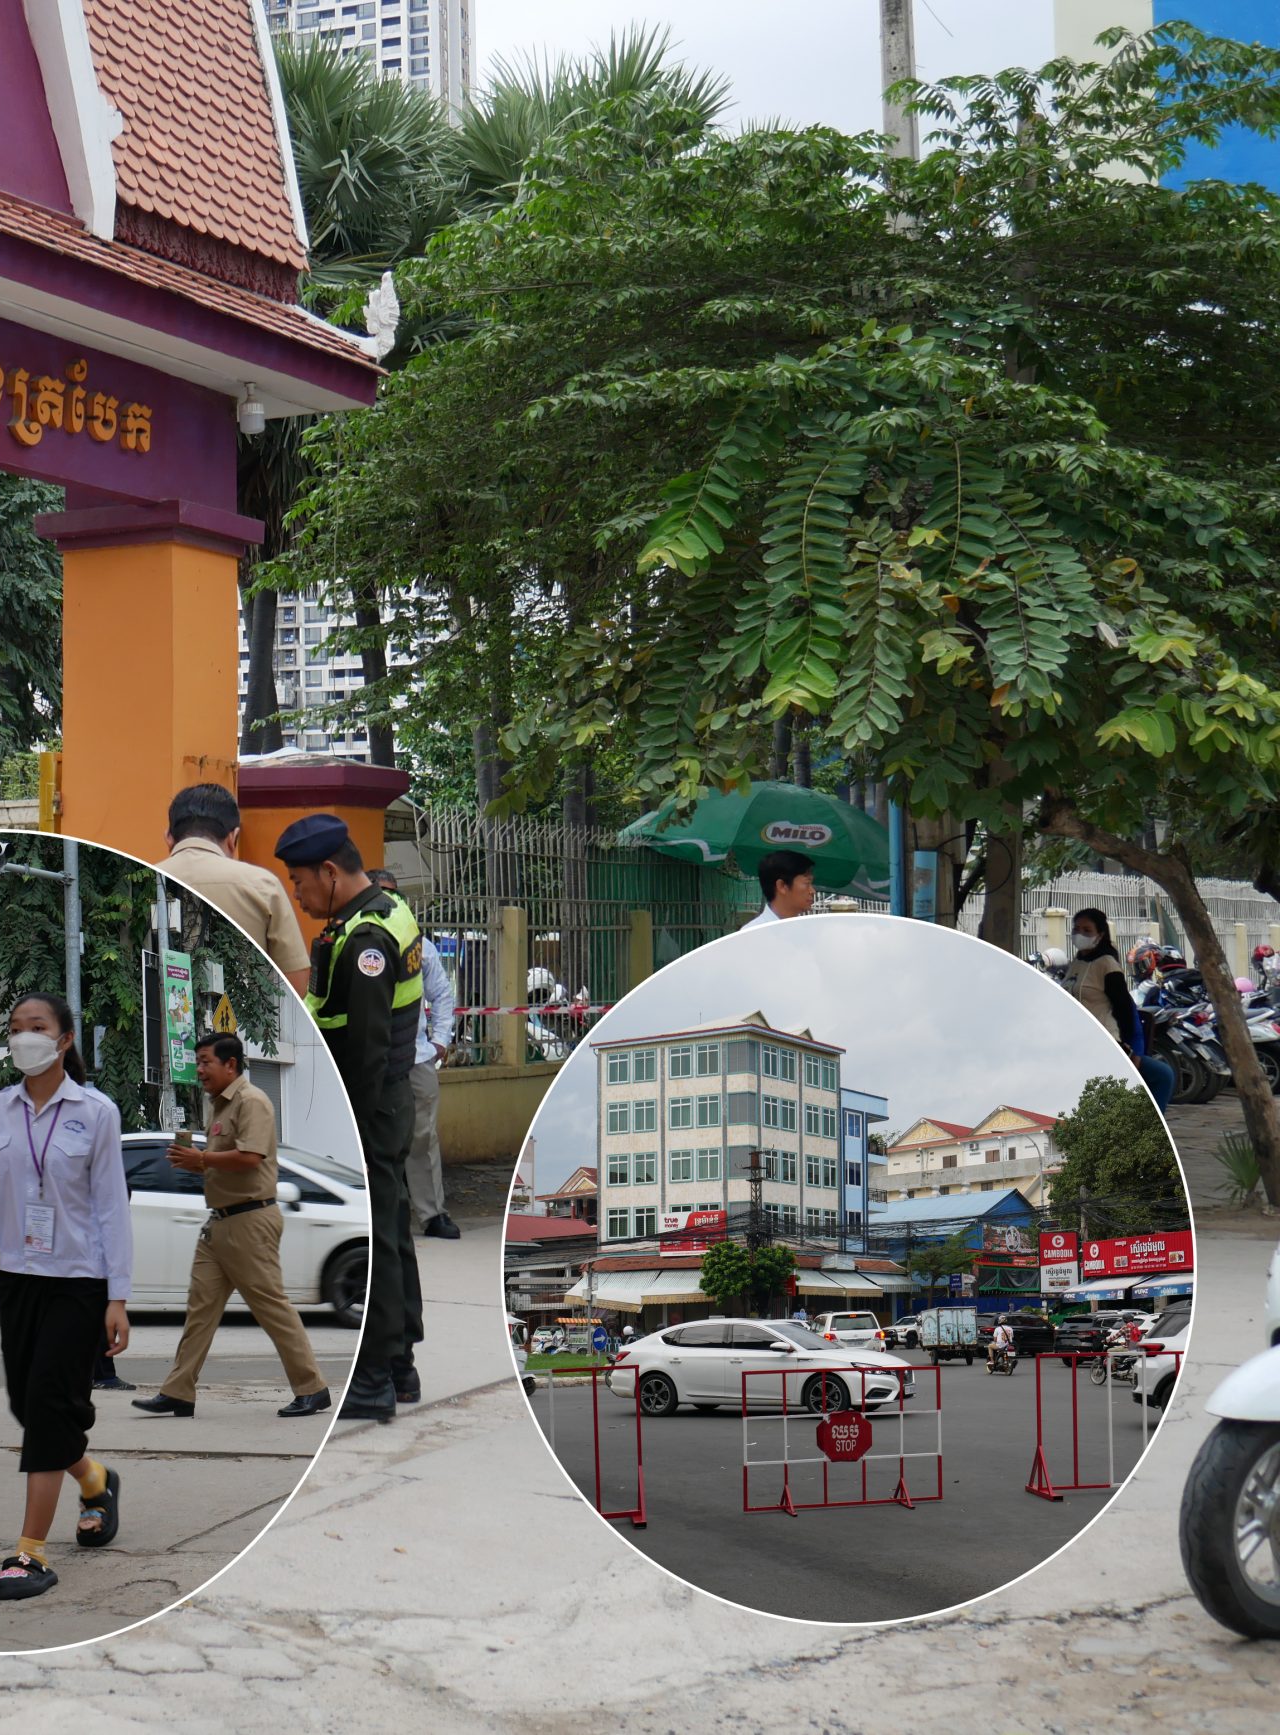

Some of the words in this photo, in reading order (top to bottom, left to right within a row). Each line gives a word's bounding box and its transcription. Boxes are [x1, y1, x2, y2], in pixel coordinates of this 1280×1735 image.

[771, 827, 826, 840] MILO
[1043, 1249, 1073, 1258] CAMBODIA
[835, 1440, 856, 1451] STOP
